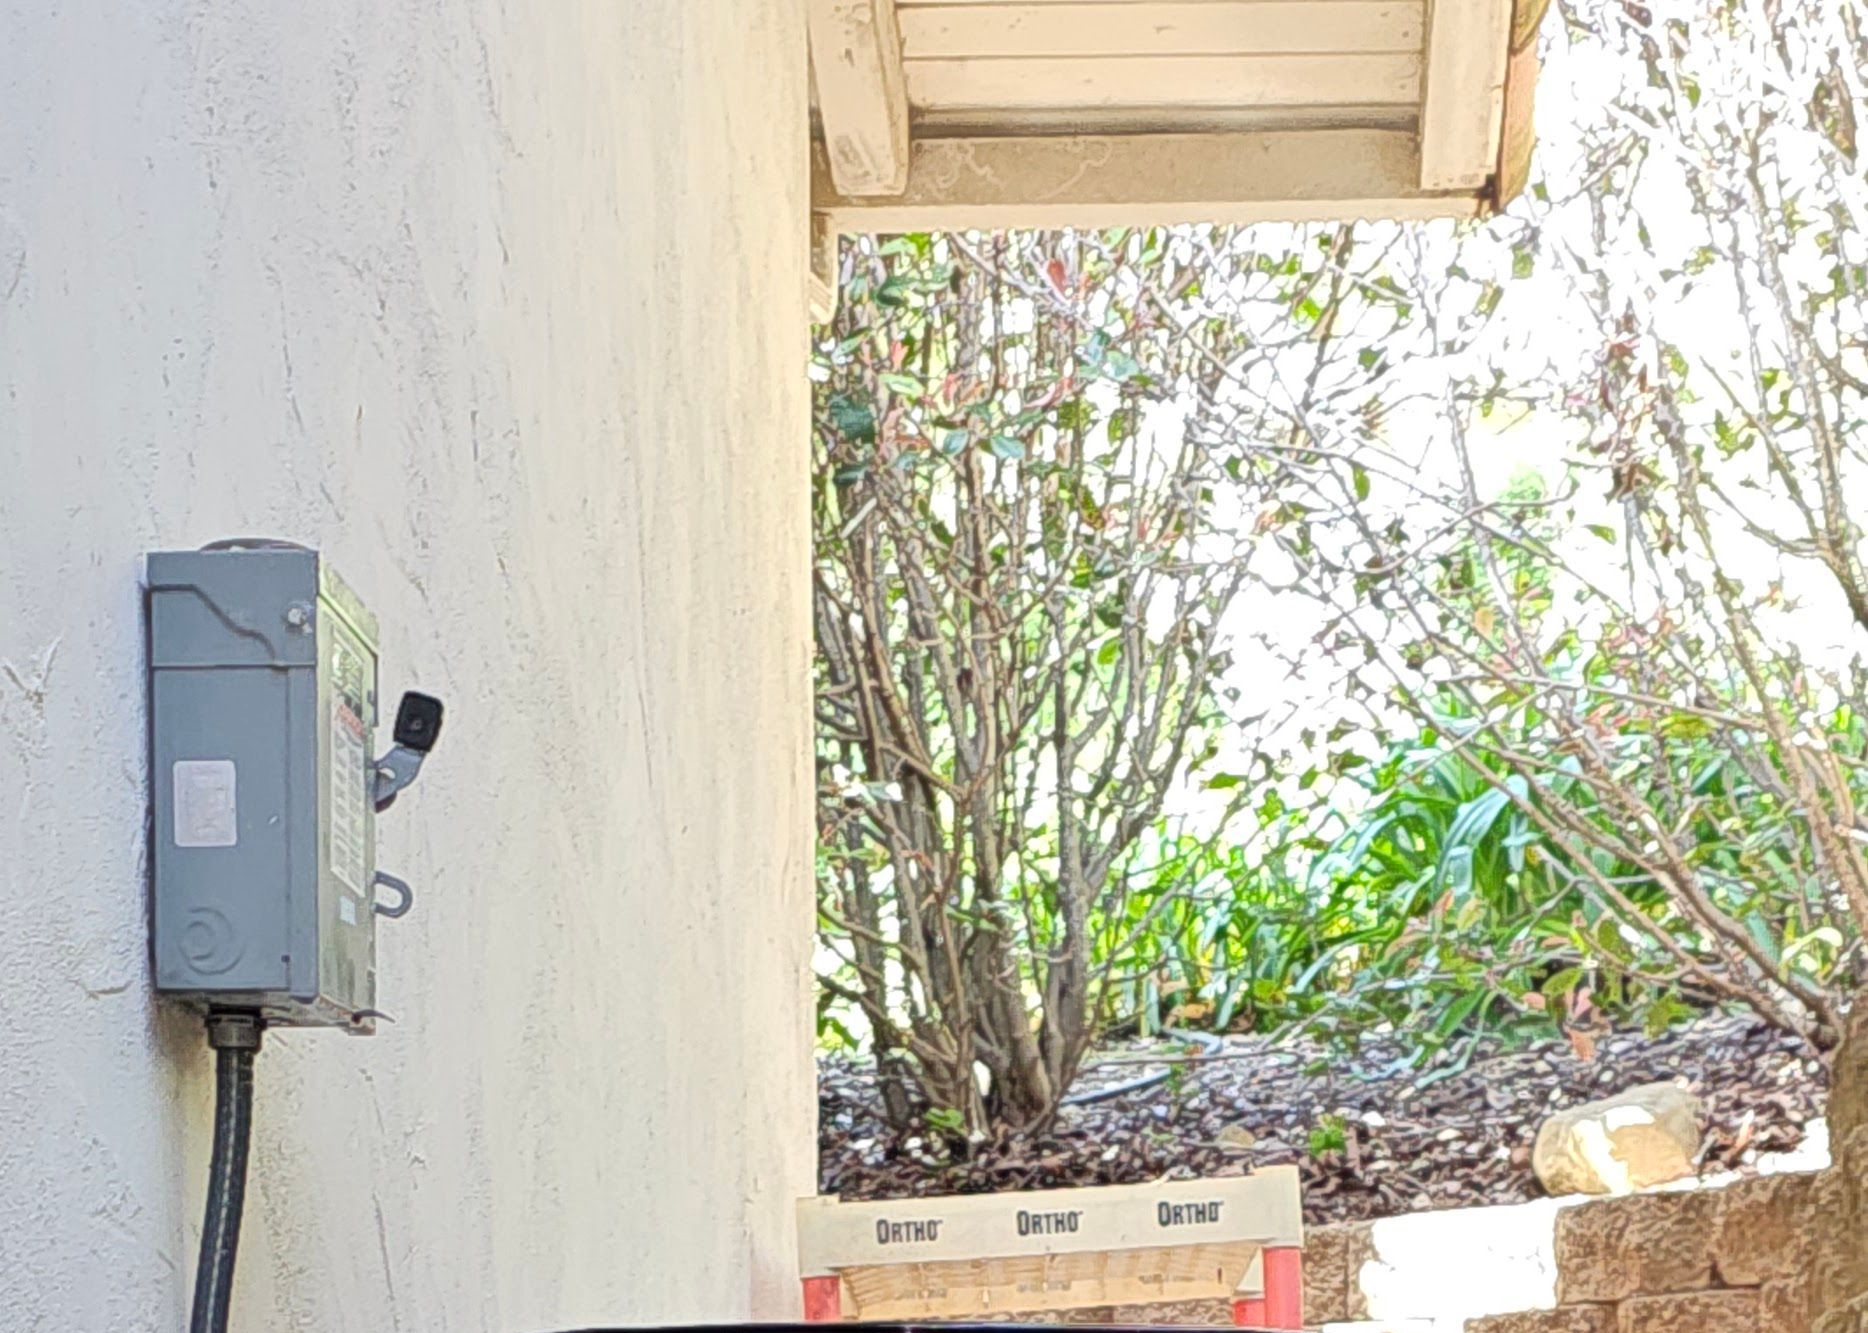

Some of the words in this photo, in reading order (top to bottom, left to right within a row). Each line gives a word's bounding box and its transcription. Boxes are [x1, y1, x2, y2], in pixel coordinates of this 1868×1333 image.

[1017, 1210, 1080, 1236] ORTHO
[1157, 1201, 1220, 1226] ORTHO
[876, 1219, 940, 1244] ORTHO
